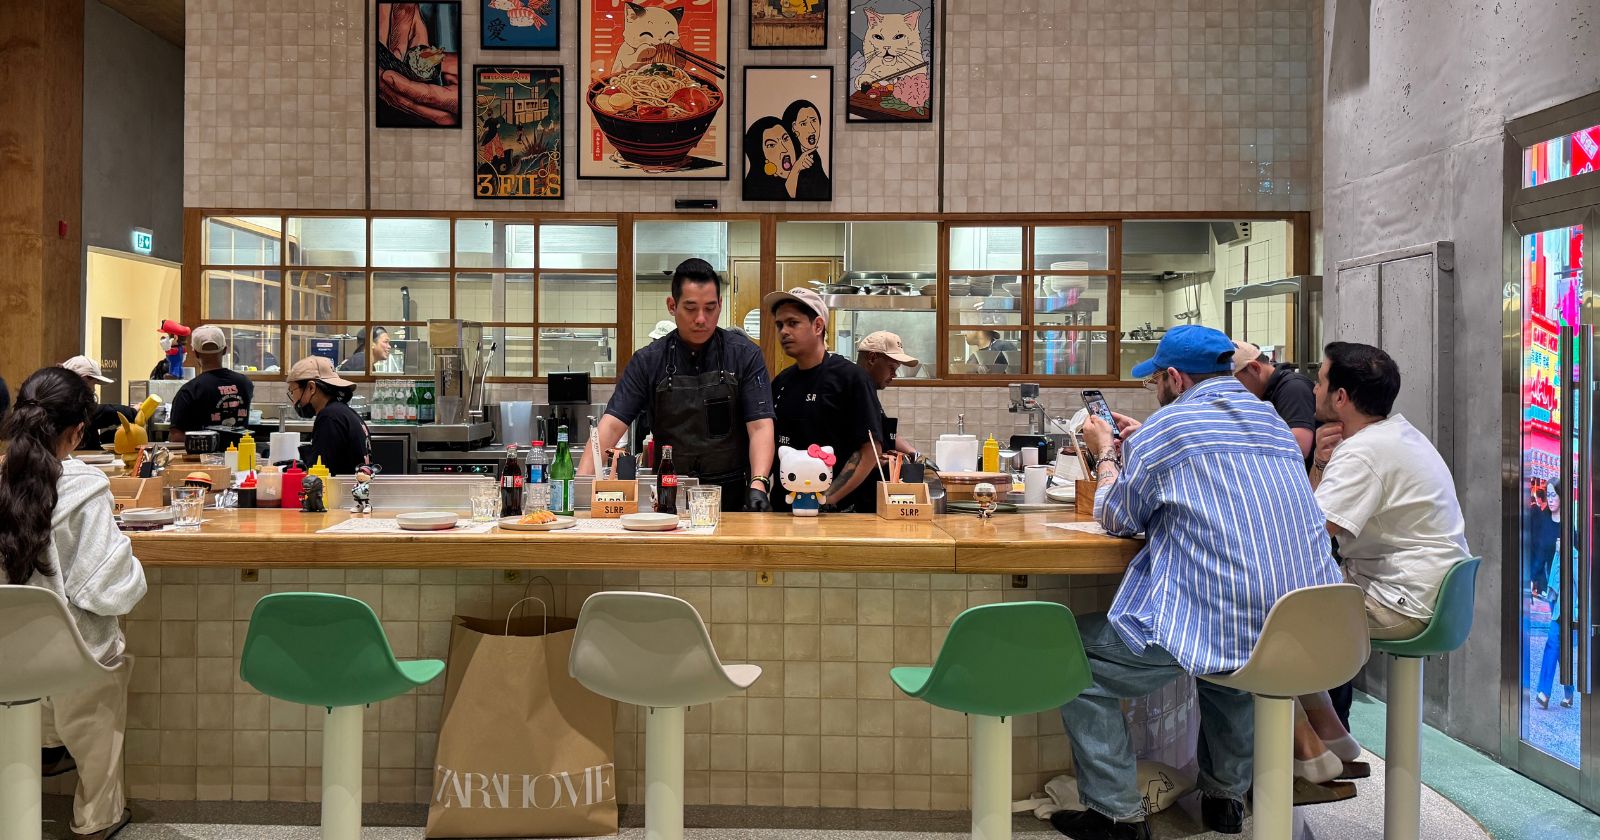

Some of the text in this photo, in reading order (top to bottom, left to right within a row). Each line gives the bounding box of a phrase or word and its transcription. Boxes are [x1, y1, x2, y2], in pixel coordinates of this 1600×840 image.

[487, 17, 508, 42] 愛
[477, 173, 561, 197] 3 FILS
[604, 505, 624, 514] SLRP.
[900, 508, 919, 517] SLRP.
